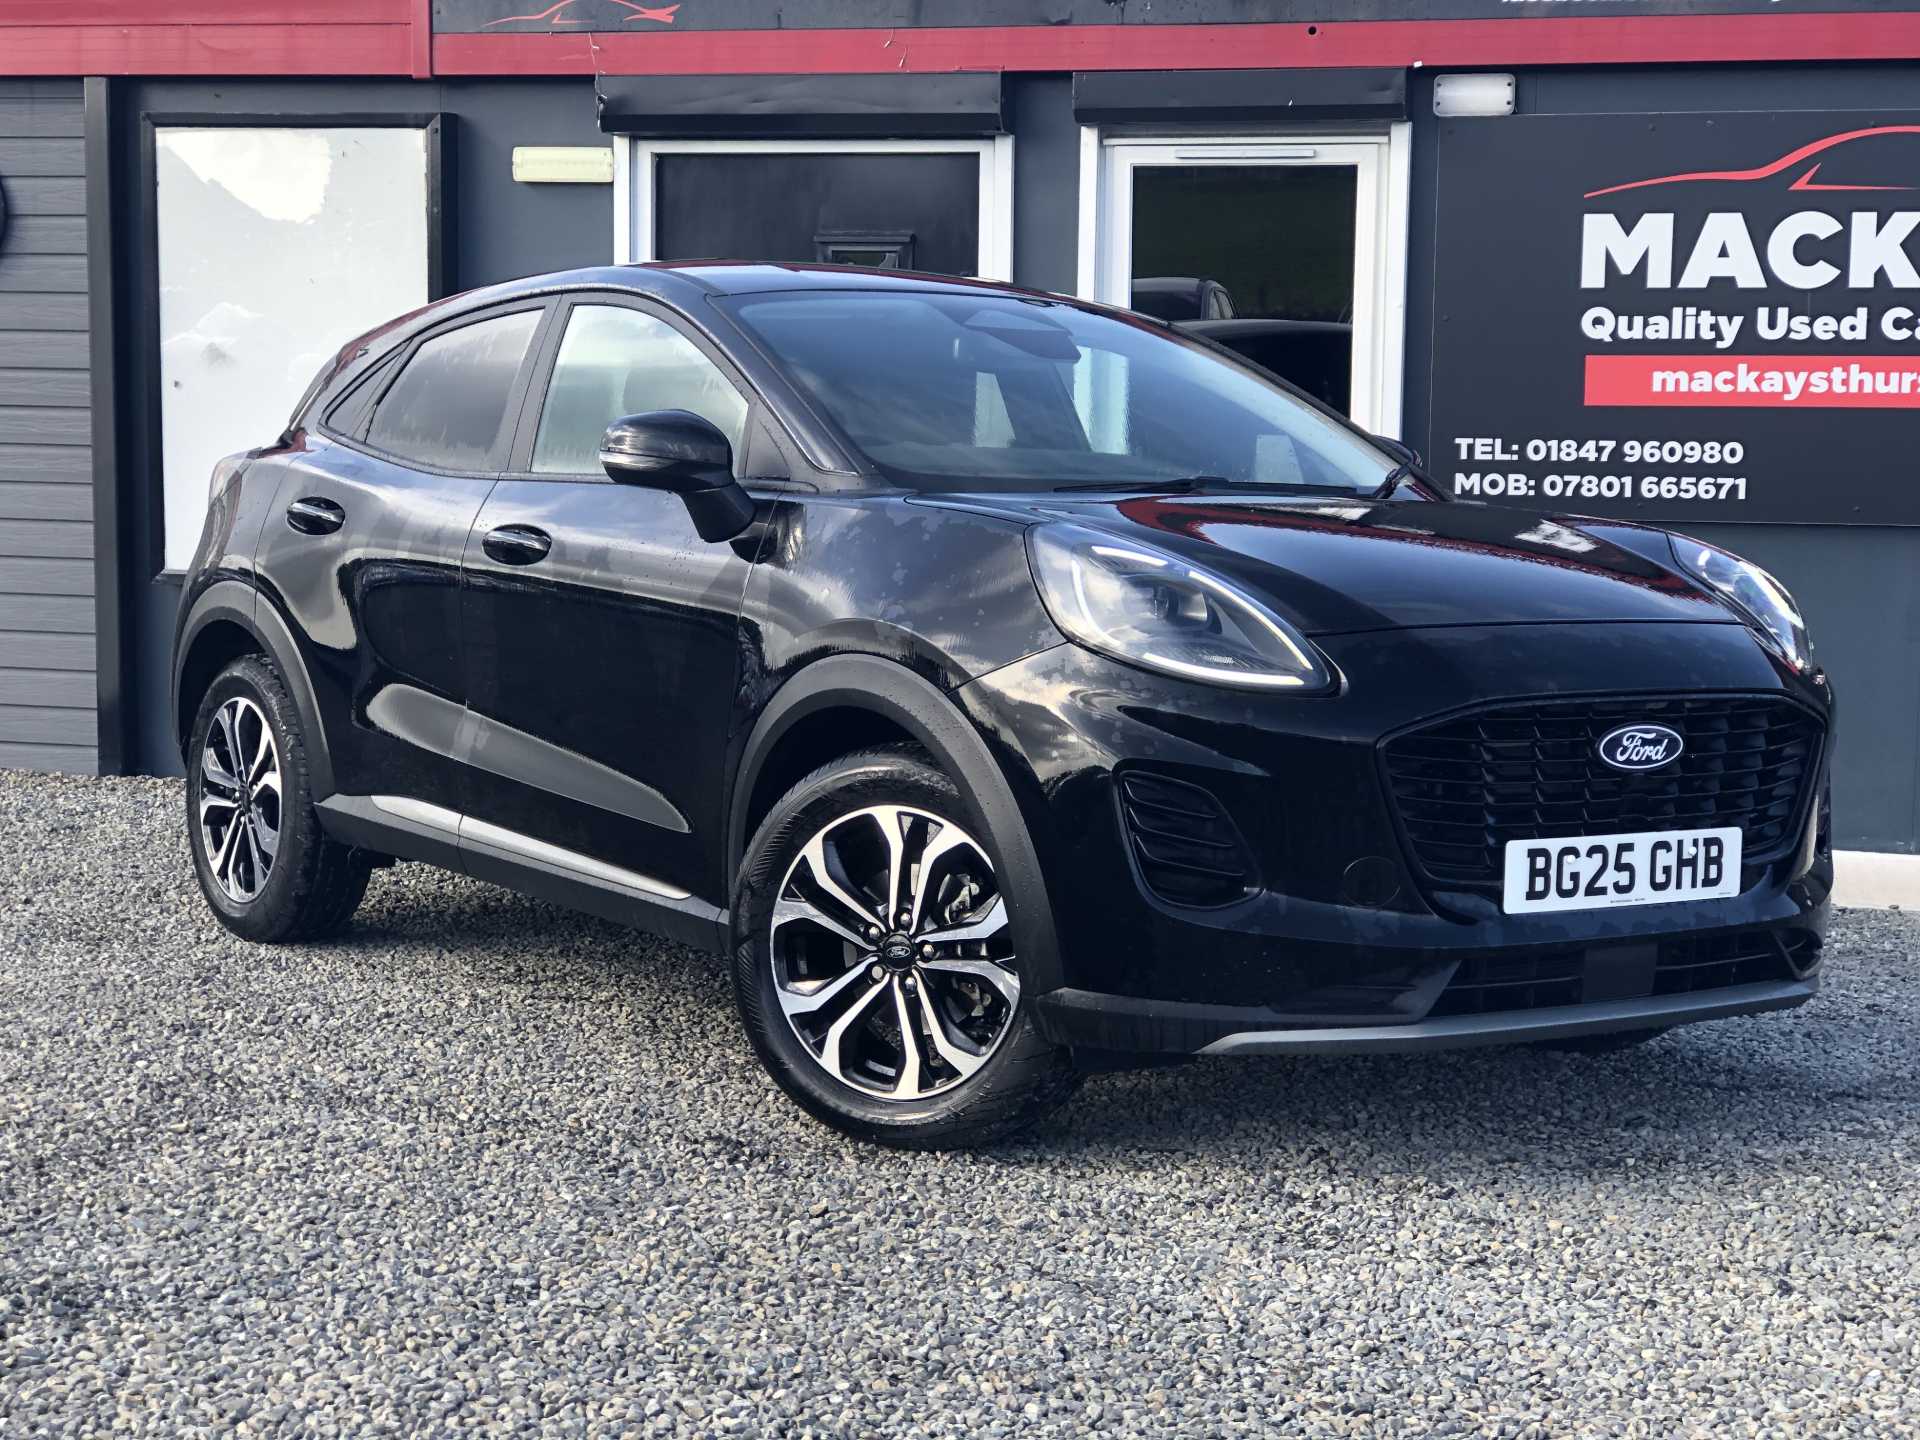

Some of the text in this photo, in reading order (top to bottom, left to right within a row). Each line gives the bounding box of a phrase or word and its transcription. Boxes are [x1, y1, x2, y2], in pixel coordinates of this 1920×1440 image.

[1581, 211, 1920, 289] MACK
[1581, 307, 1920, 348] Quality Used C
[1652, 363, 1920, 401] mackaysthur
[1455, 438, 1744, 464] TEL: 01847 960980
[1454, 473, 1747, 500] MOB: 07801 665671
[1616, 731, 1669, 762] Ford
[1525, 836, 1724, 901] BG25 GHB
